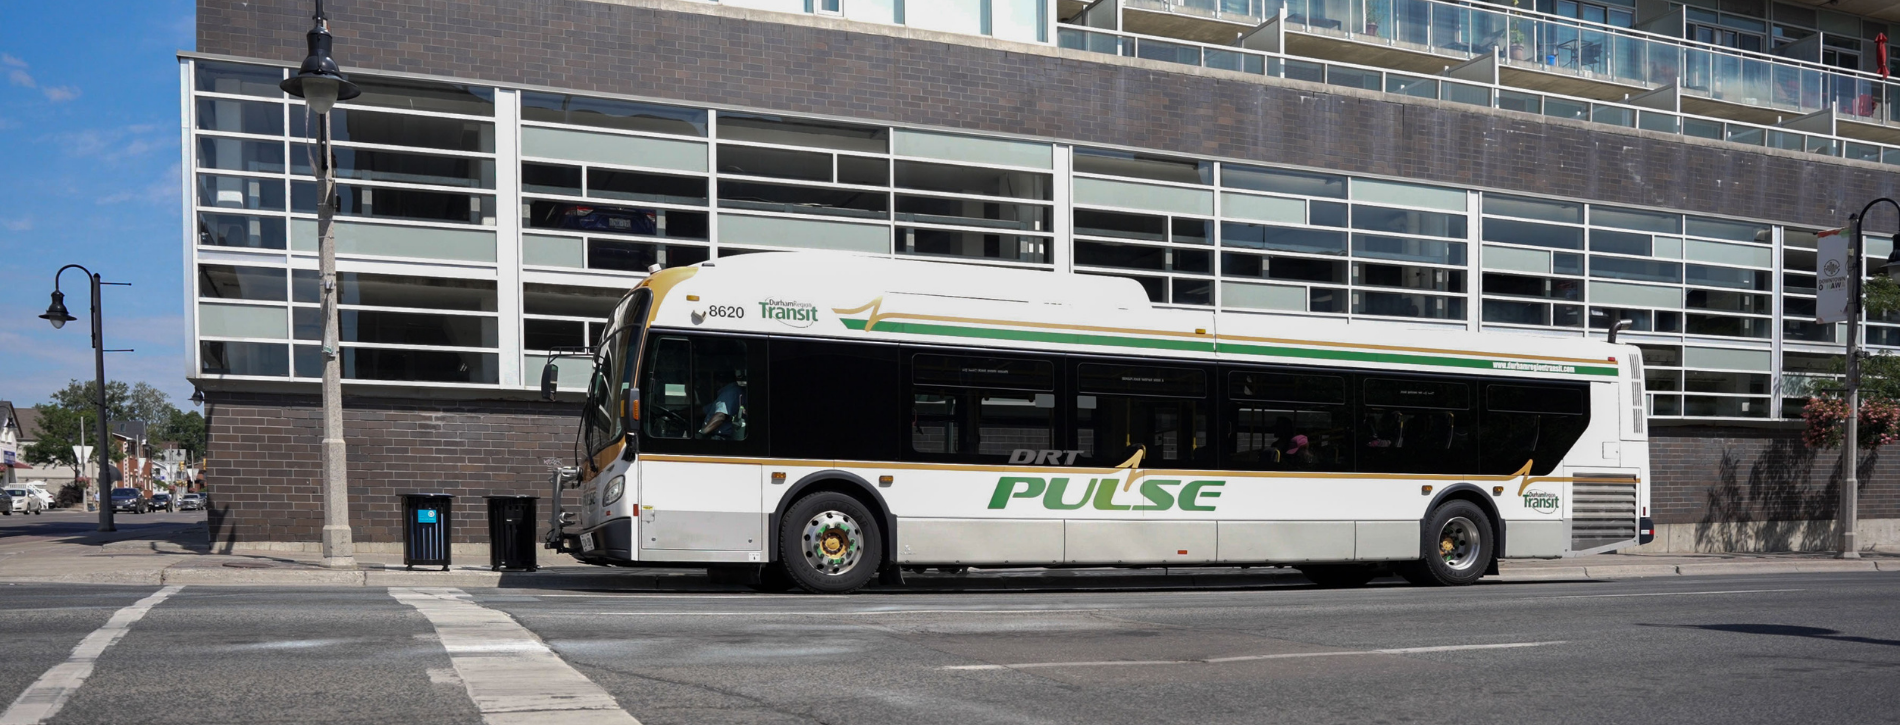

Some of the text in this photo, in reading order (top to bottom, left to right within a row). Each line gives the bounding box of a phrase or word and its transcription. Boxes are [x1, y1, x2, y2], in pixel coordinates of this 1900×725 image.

[708, 304, 745, 319] 8620
[758, 301, 819, 322] Transit
[1492, 361, 1576, 374] www.durhamregiontransit.com
[1008, 448, 1085, 466] DRT
[987, 476, 1226, 512] PULSE
[1522, 494, 1560, 509] Transit
